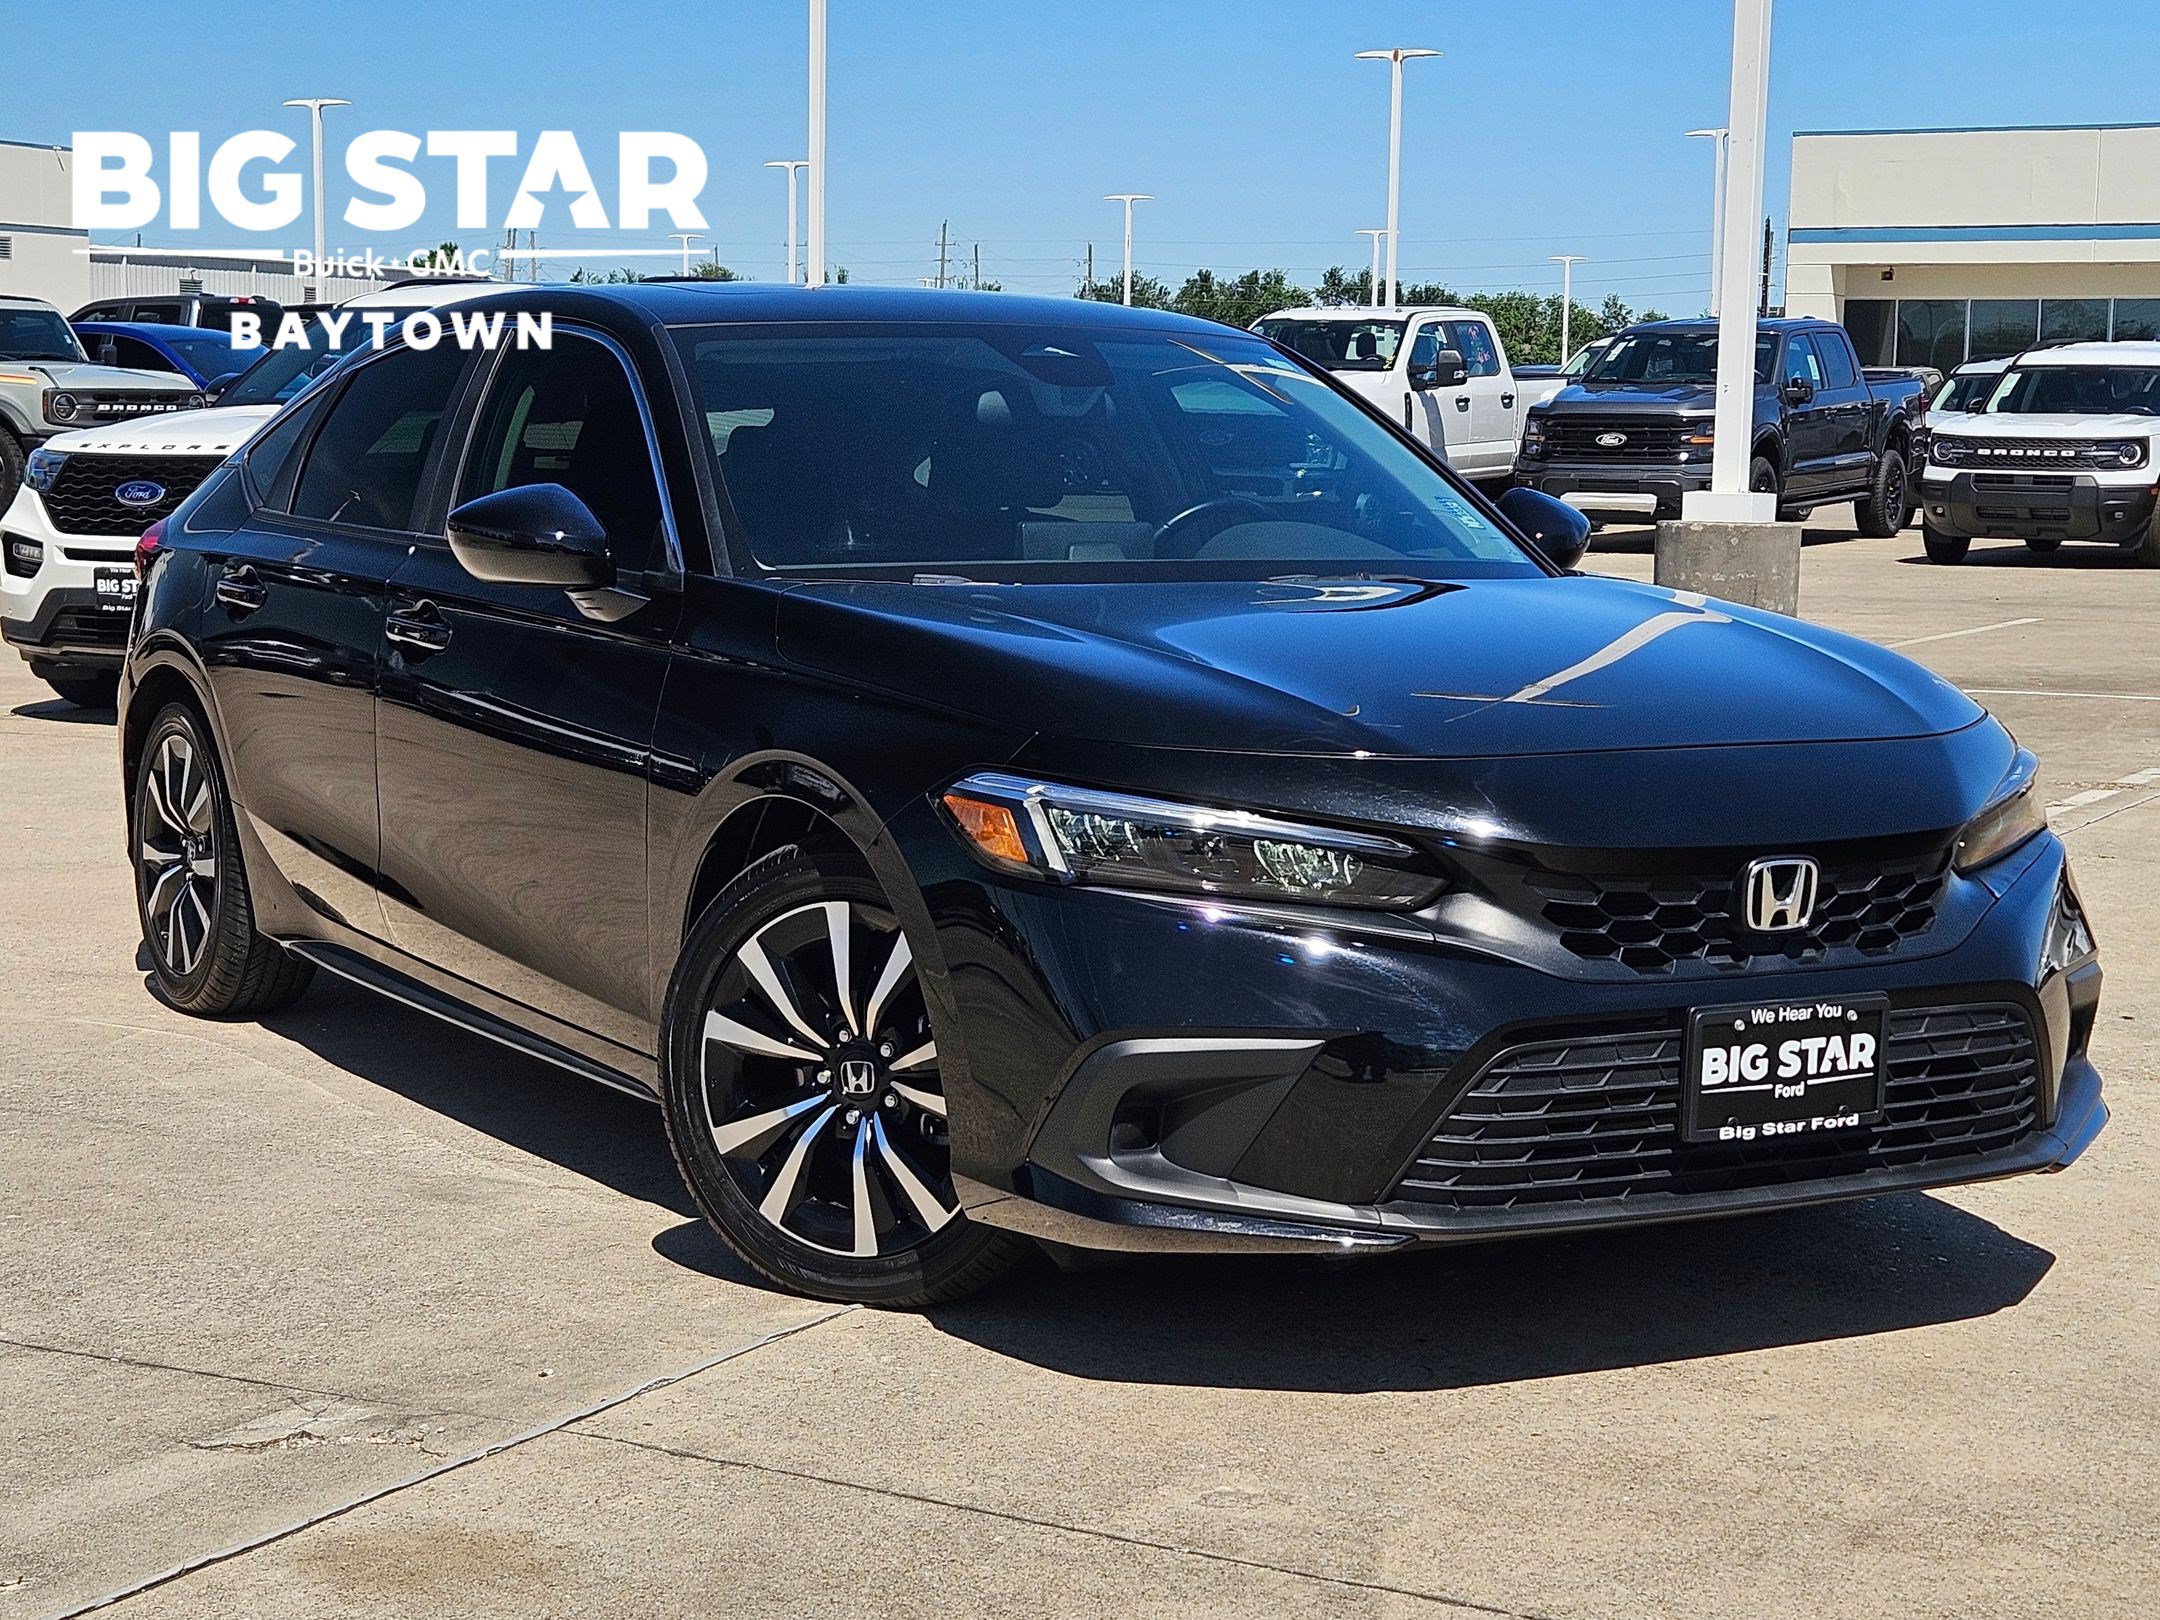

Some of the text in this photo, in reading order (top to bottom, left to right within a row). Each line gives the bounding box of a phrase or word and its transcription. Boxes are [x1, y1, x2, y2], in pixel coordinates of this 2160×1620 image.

[1977, 448, 2075, 457] BRONCO
[97, 579, 138, 593] BIG ST
[1751, 1003, 1843, 1025] We Hear You
[1701, 1032, 1876, 1086] BIG STAR
[1774, 1081, 1805, 1099] Ford
[1719, 1113, 1860, 1141] Big Star Ford
